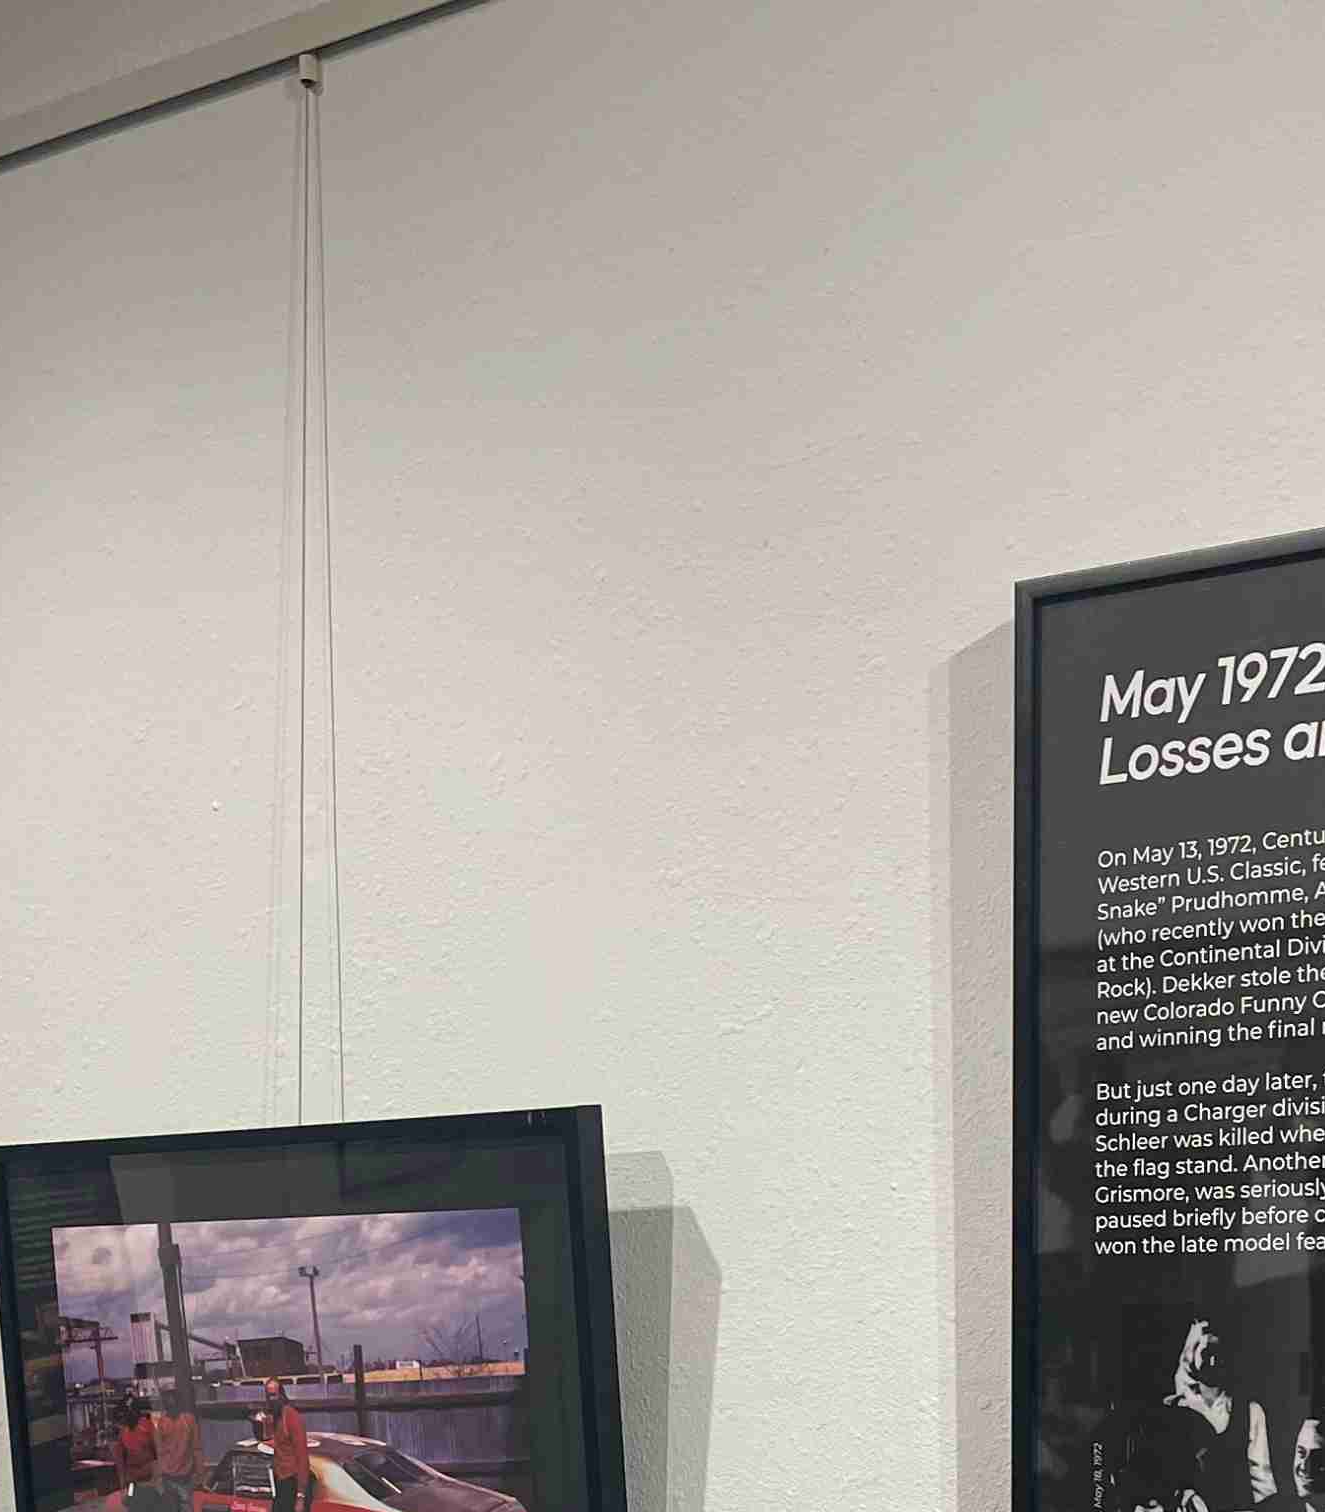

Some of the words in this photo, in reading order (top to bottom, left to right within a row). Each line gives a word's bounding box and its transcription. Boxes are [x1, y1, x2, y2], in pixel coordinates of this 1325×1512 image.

[1099, 669, 1207, 723] May
[1099, 728, 1271, 785] Losses
[1097, 850, 1126, 868] On
[1133, 845, 1174, 866] May
[1177, 840, 1202, 860] 13,
[1207, 834, 1256, 856] 1972,
[1097, 872, 1180, 894] Western
[1187, 864, 1224, 885] U.S.
[1230, 856, 1306, 880] Classic,
